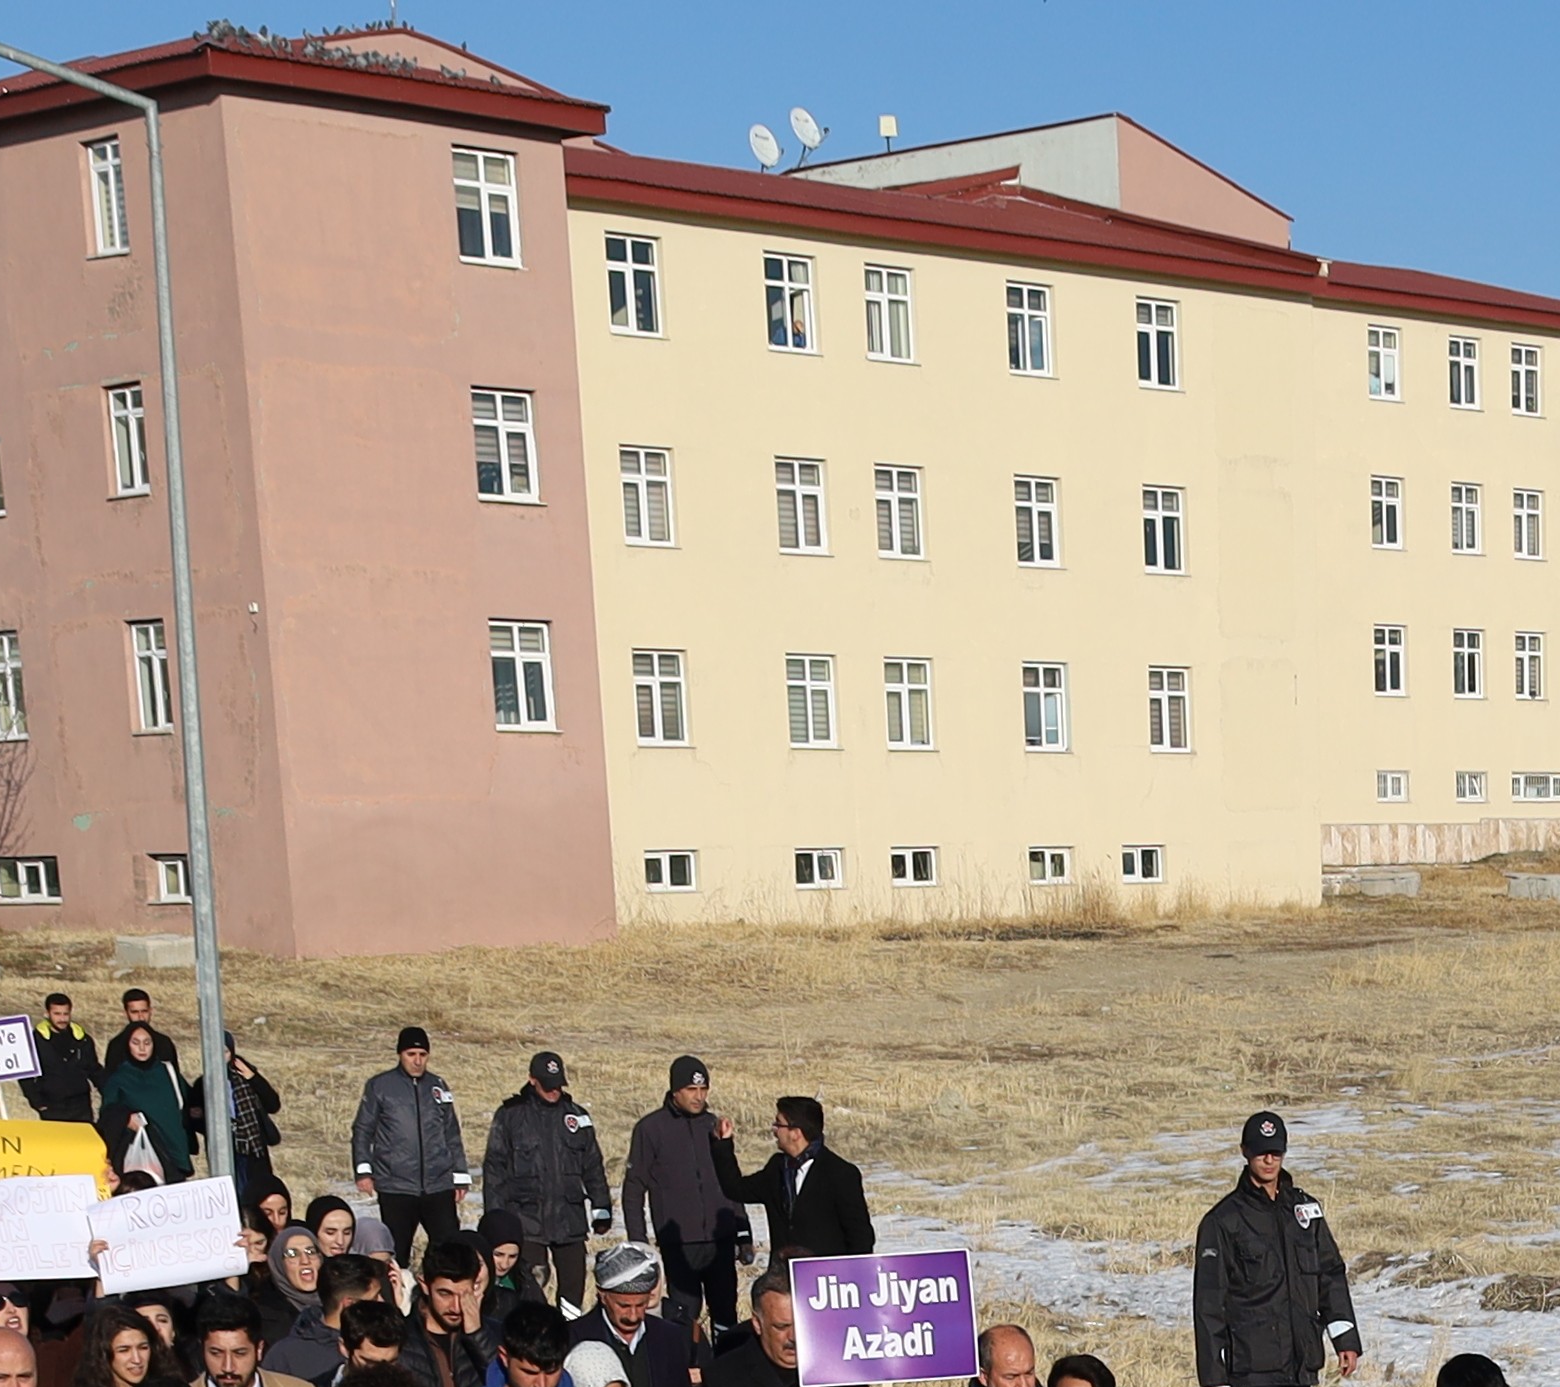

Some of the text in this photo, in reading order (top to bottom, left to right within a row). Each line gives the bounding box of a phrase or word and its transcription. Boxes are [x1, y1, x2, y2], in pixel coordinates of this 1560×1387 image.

[5, 1053, 20, 1070] ol
[808, 1271, 959, 1313] Jin Jiyan
[842, 1321, 934, 1361] Azadî
